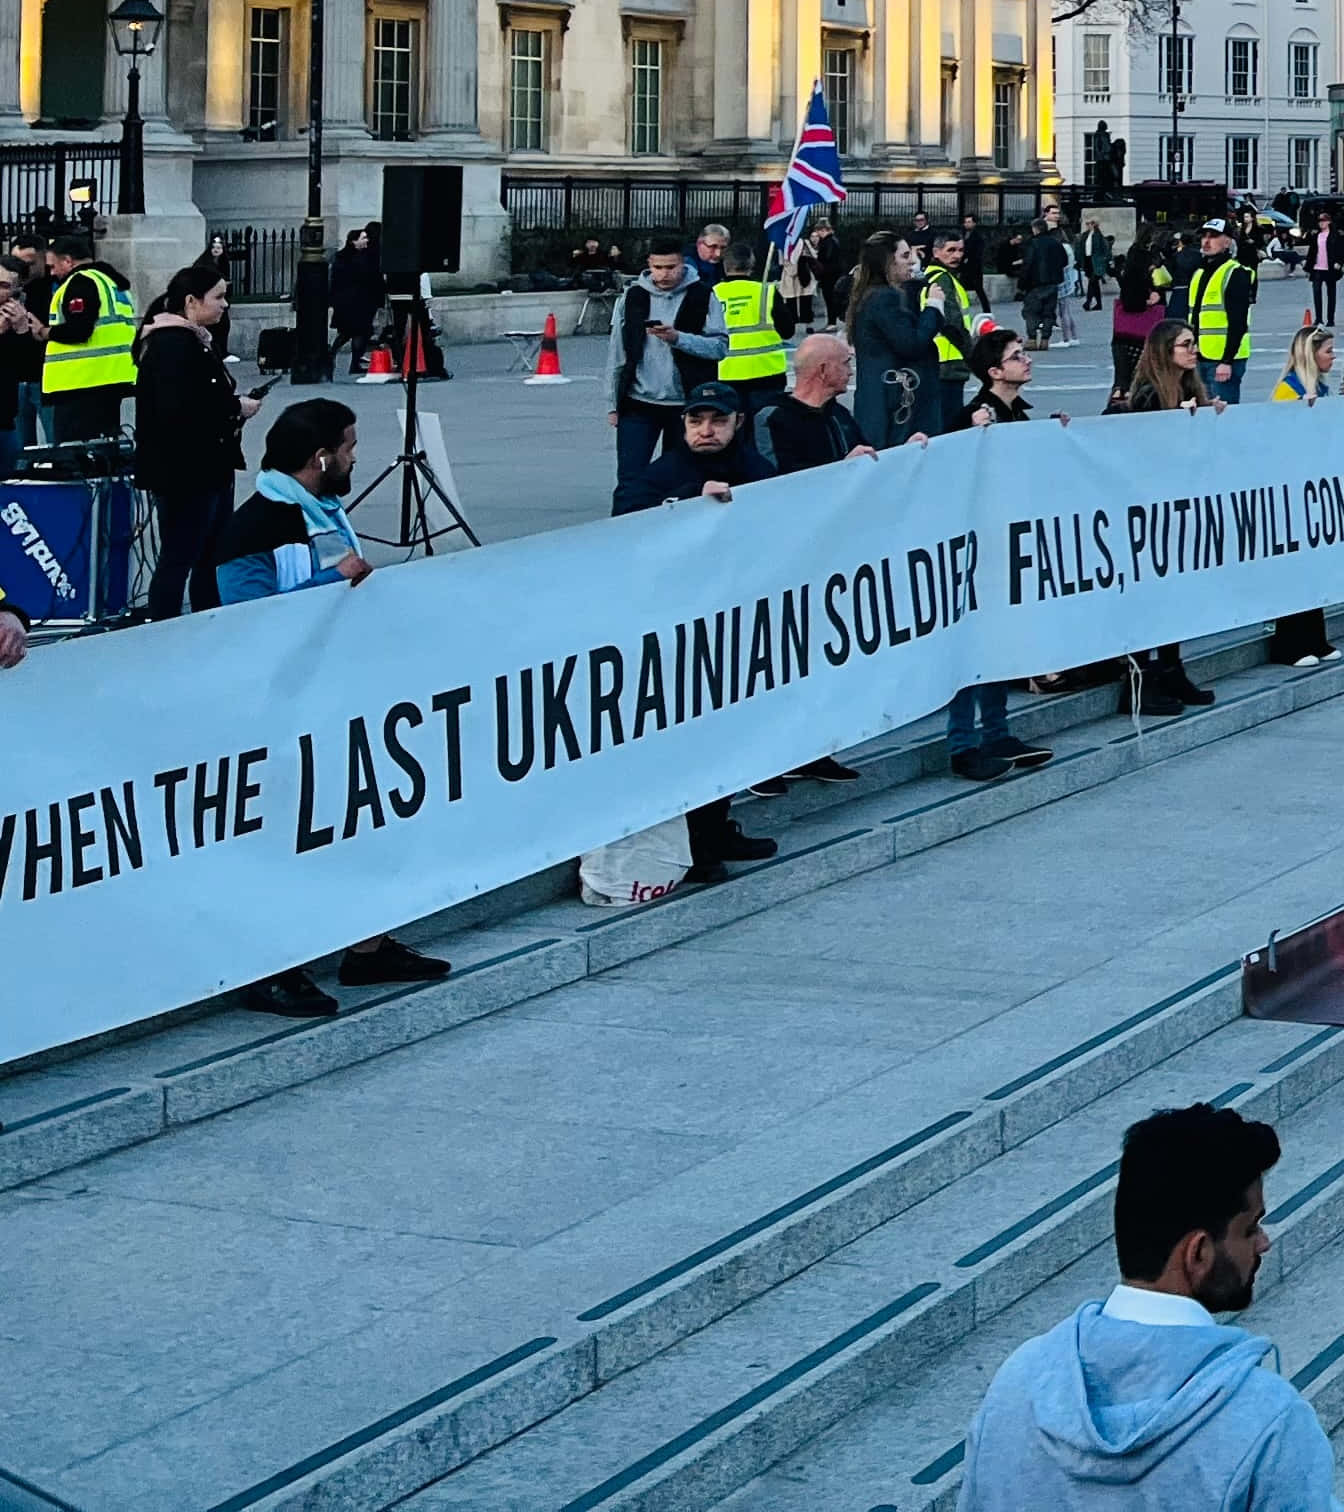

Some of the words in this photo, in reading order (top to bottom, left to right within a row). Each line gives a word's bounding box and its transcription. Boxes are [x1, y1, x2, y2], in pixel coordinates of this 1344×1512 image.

[154, 747, 268, 857] THE
[295, 686, 471, 854] LAST
[496, 584, 810, 782] UKRAINIAN
[823, 530, 978, 667] SOLDIER
[1009, 509, 1125, 605] FALLS,
[1128, 494, 1226, 582] PUTIN
[1230, 485, 1300, 562] WILL
